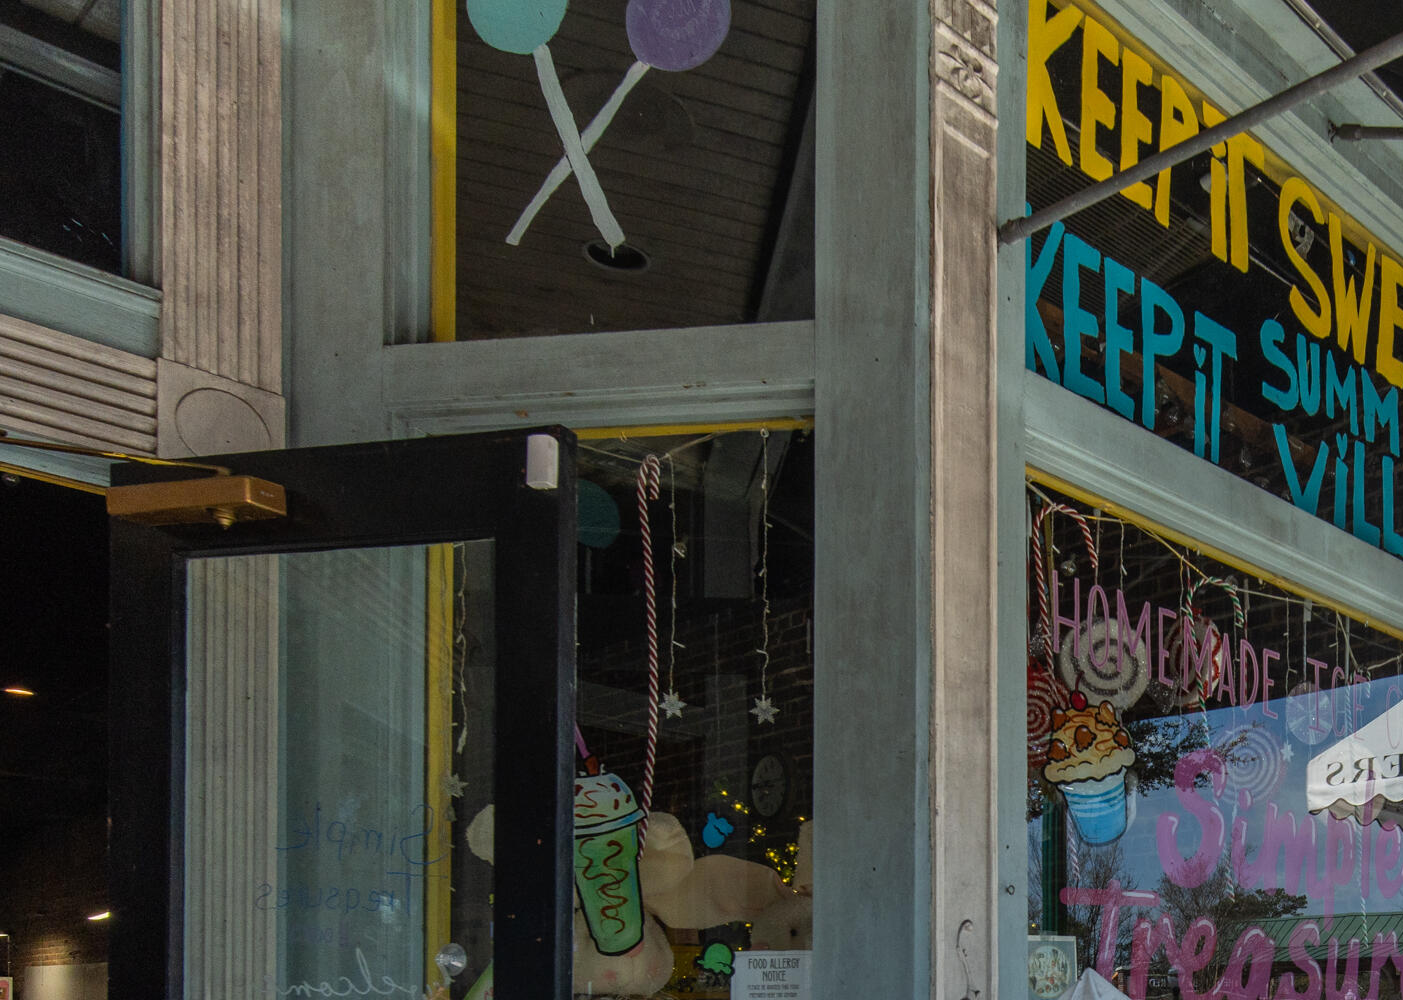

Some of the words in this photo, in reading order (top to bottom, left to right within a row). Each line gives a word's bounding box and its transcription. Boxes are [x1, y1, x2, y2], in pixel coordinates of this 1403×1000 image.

[1026, 0, 1200, 229] KEEP
[1026, 201, 1186, 431] KEEP
[1051, 569, 1281, 720] HOMEMADE
[1306, 656, 1367, 742] ICE
[748, 958, 767, 969] FOOD
[769, 957, 801, 969] ALLERGY
[762, 970, 787, 981] NOTICE
